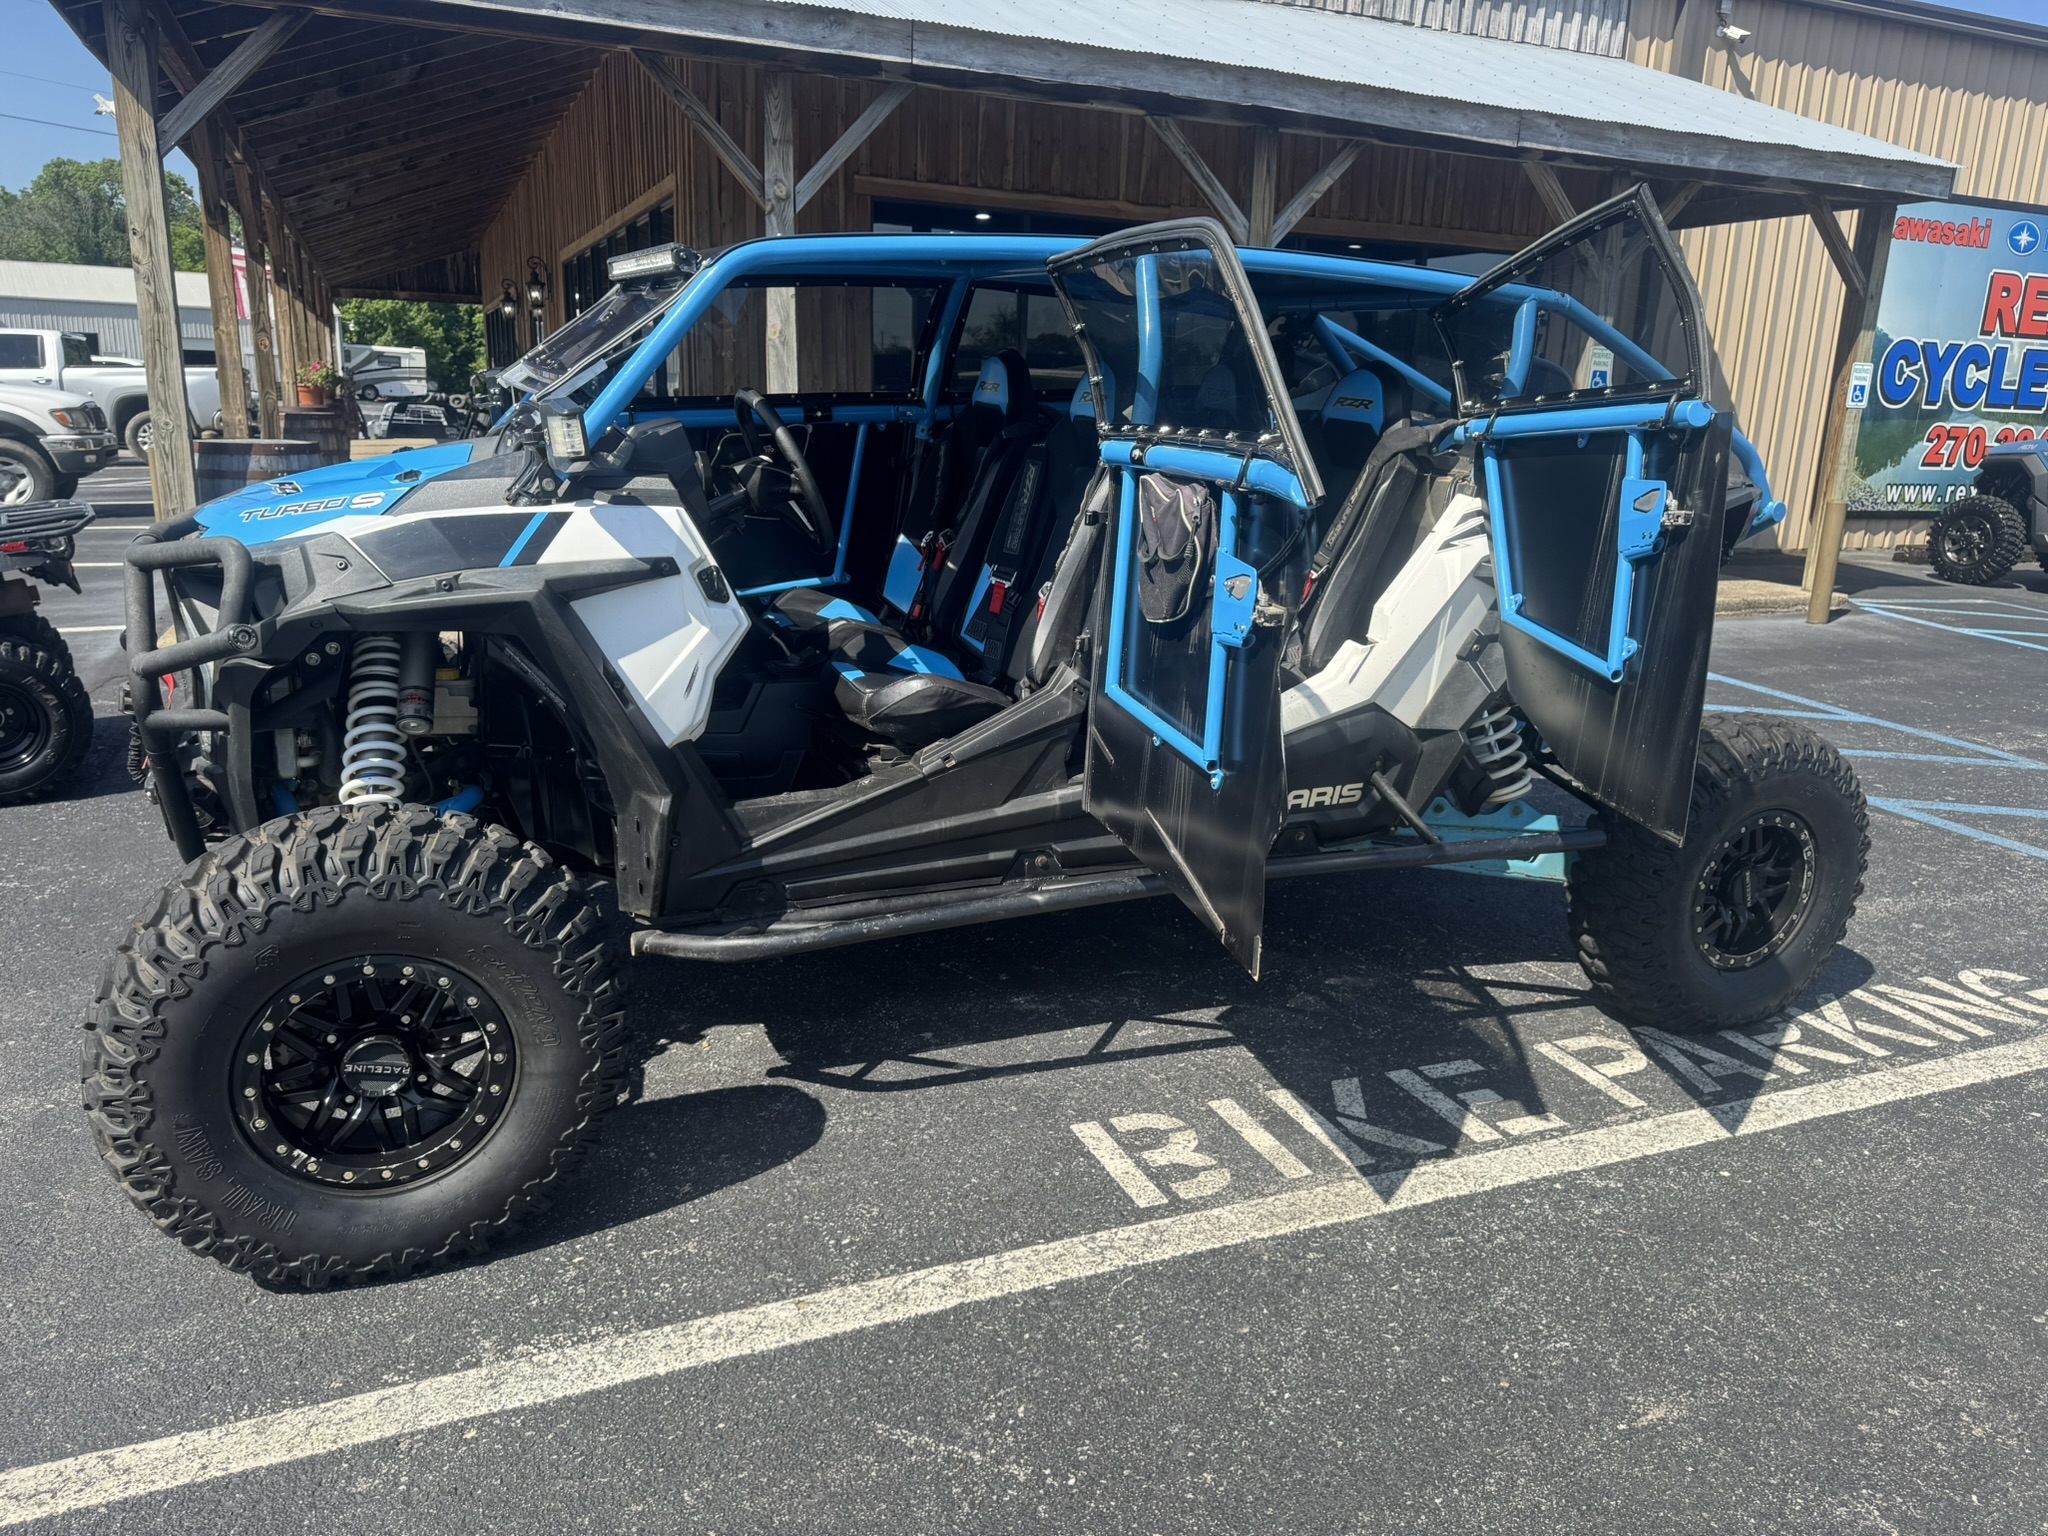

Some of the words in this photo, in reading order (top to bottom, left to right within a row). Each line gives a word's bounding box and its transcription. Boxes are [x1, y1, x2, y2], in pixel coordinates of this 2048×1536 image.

[1891, 216, 1993, 249] awasaki
[977, 381, 1000, 392] RZR
[1878, 339, 2048, 414] CYCLE
[1333, 396, 1375, 410] RZR
[239, 495, 350, 523] TURBO
[348, 491, 387, 510] S
[343, 1063, 411, 1075] RACELINE
[1070, 1058, 1570, 1208] BIKE
[1534, 967, 2048, 1108] PARKING
[172, 1125, 224, 1182] SAW
[217, 1176, 299, 1239] TRAIL
